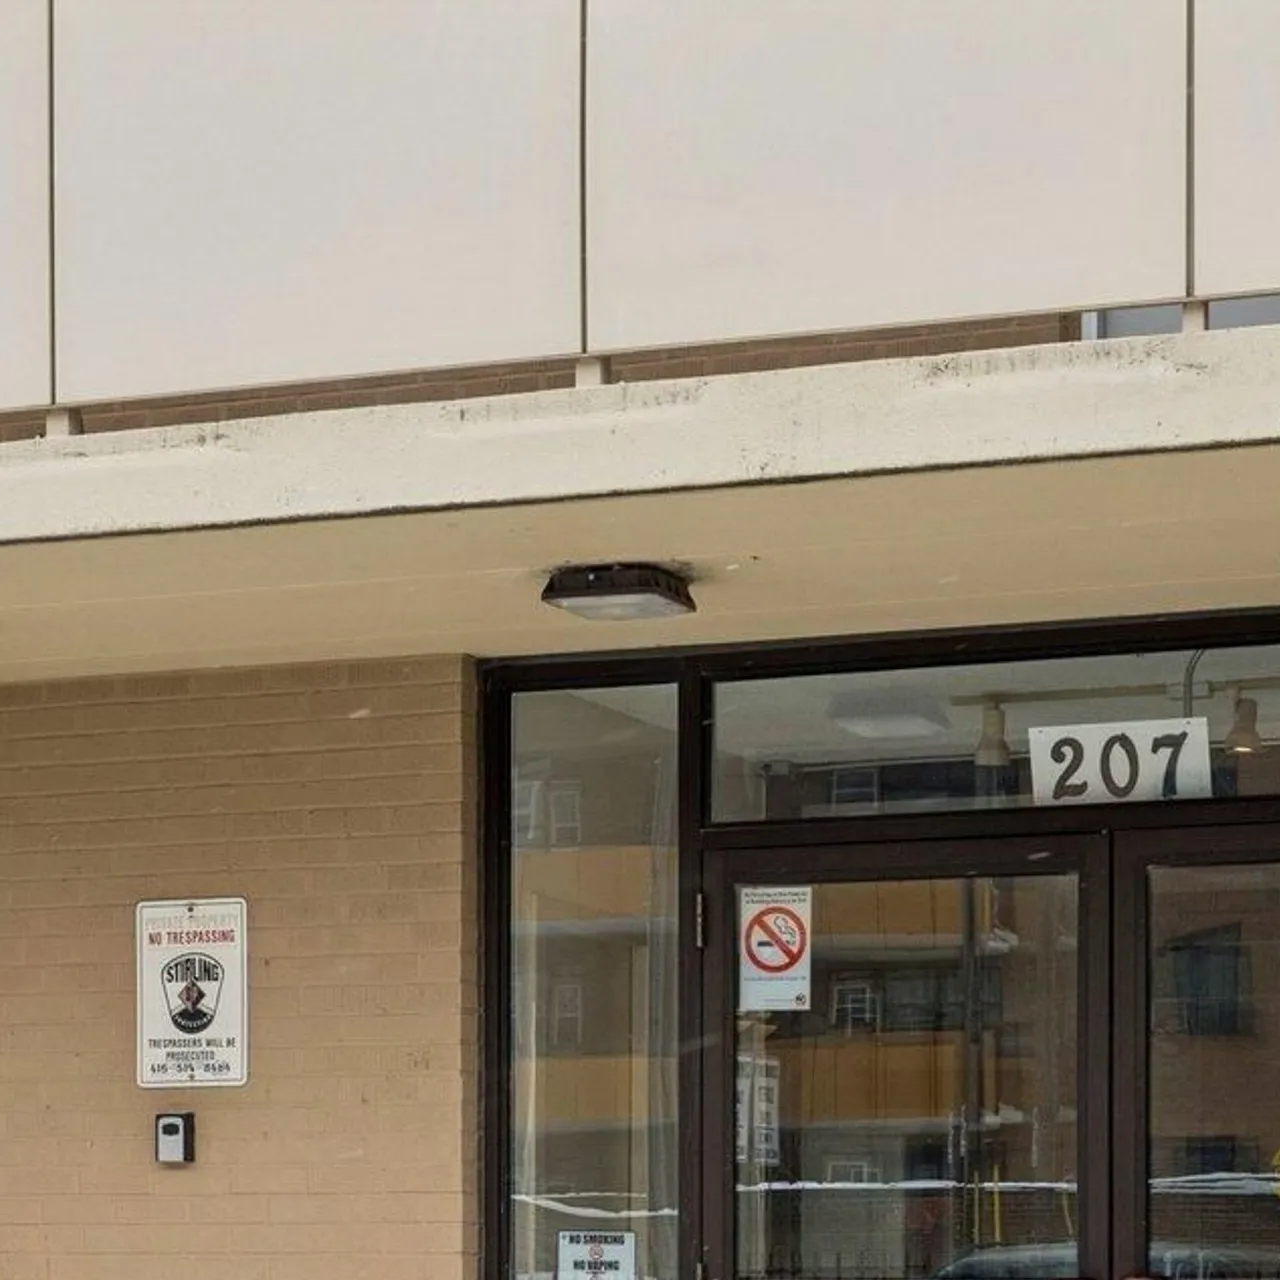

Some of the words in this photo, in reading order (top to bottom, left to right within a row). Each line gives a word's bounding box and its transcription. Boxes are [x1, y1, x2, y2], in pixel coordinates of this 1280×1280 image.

[1050, 730, 1189, 800] 207
[148, 931, 162, 945] NO
[166, 929, 235, 945] TRESPASSING
[165, 957, 219, 983] STIRLING
[148, 1037, 202, 1049] TRESPASSERS
[205, 1037, 224, 1048] WILL
[226, 1037, 236, 1047] BE
[165, 1051, 215, 1061] PROSECUTED
[569, 1234, 582, 1245] NO
[583, 1234, 625, 1245] SMOKING
[573, 1260, 586, 1270] NO
